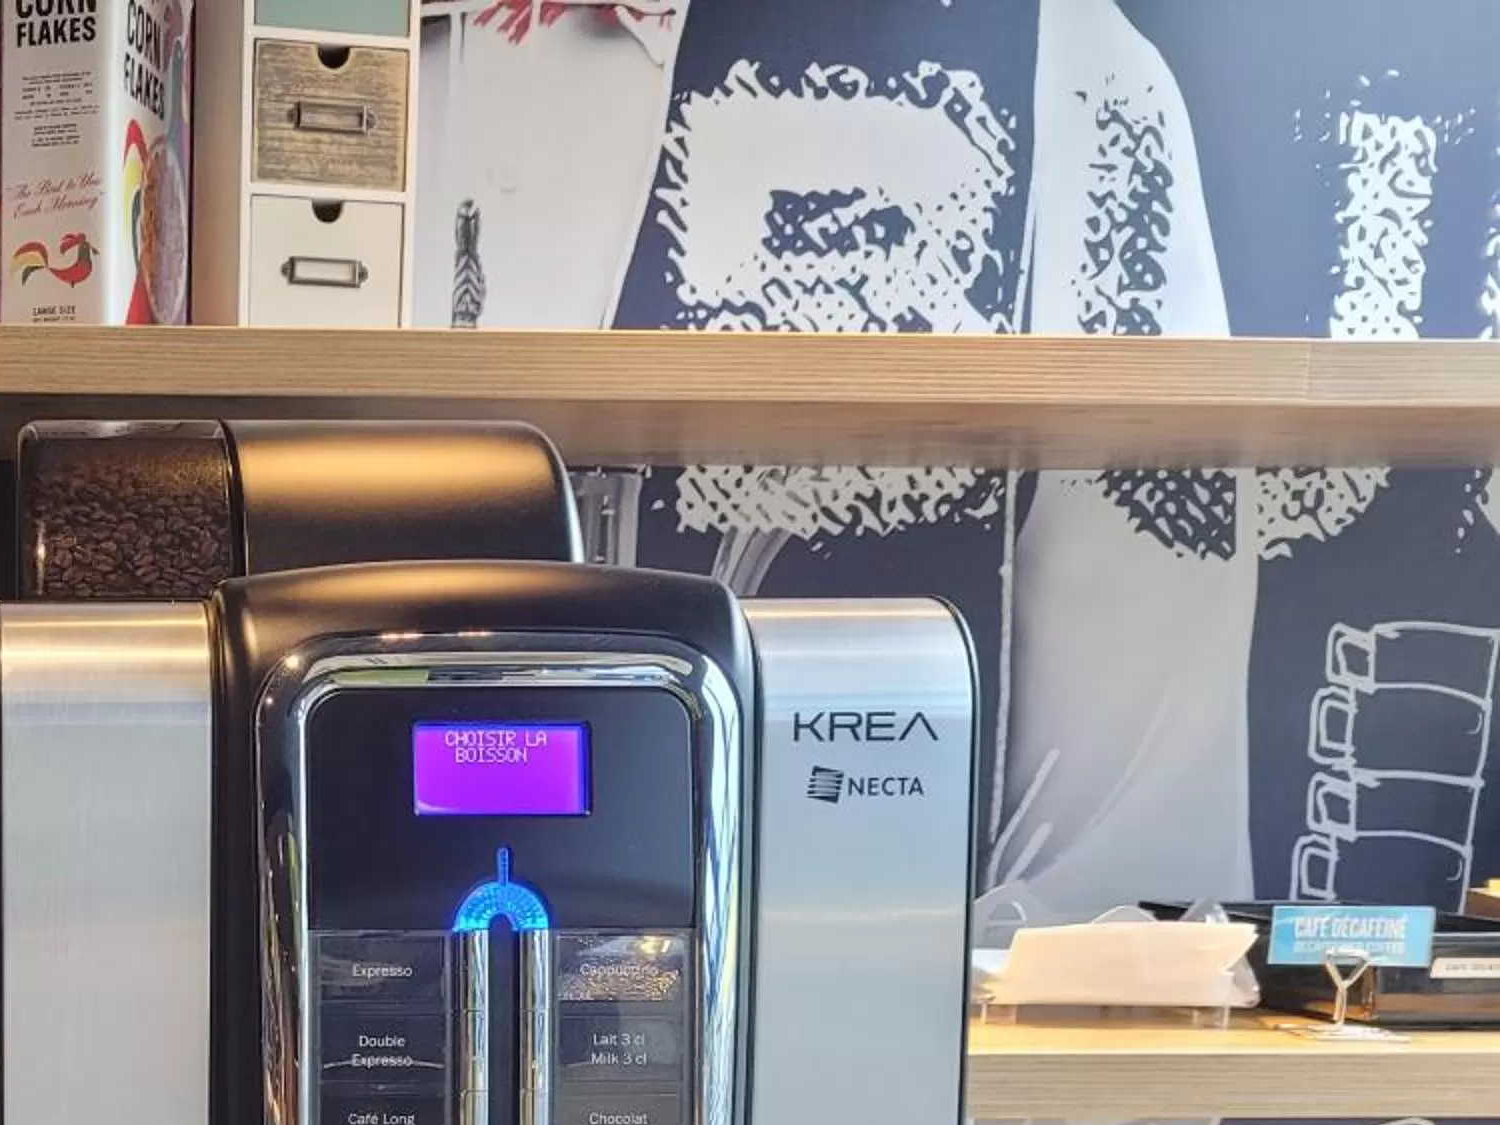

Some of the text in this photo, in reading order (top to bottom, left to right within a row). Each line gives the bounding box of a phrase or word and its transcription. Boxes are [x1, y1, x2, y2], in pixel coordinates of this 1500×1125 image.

[16, 16, 97, 48] FLAKES
[127, 0, 161, 71] CORN
[124, 52, 165, 121] FLAKES
[793, 711, 939, 742] KREA
[445, 731, 548, 747] CHOISIR LA
[456, 748, 528, 763] BOISSON
[848, 777, 924, 796] NECTA
[353, 965, 412, 979] Expresso
[359, 1035, 405, 1047] Double
[594, 1034, 617, 1046] Lait
[352, 1054, 412, 1068] Expresso
[592, 1053, 618, 1065] Milk
[348, 1112, 378, 1125] Café
[589, 1113, 648, 1125] Chocolat
